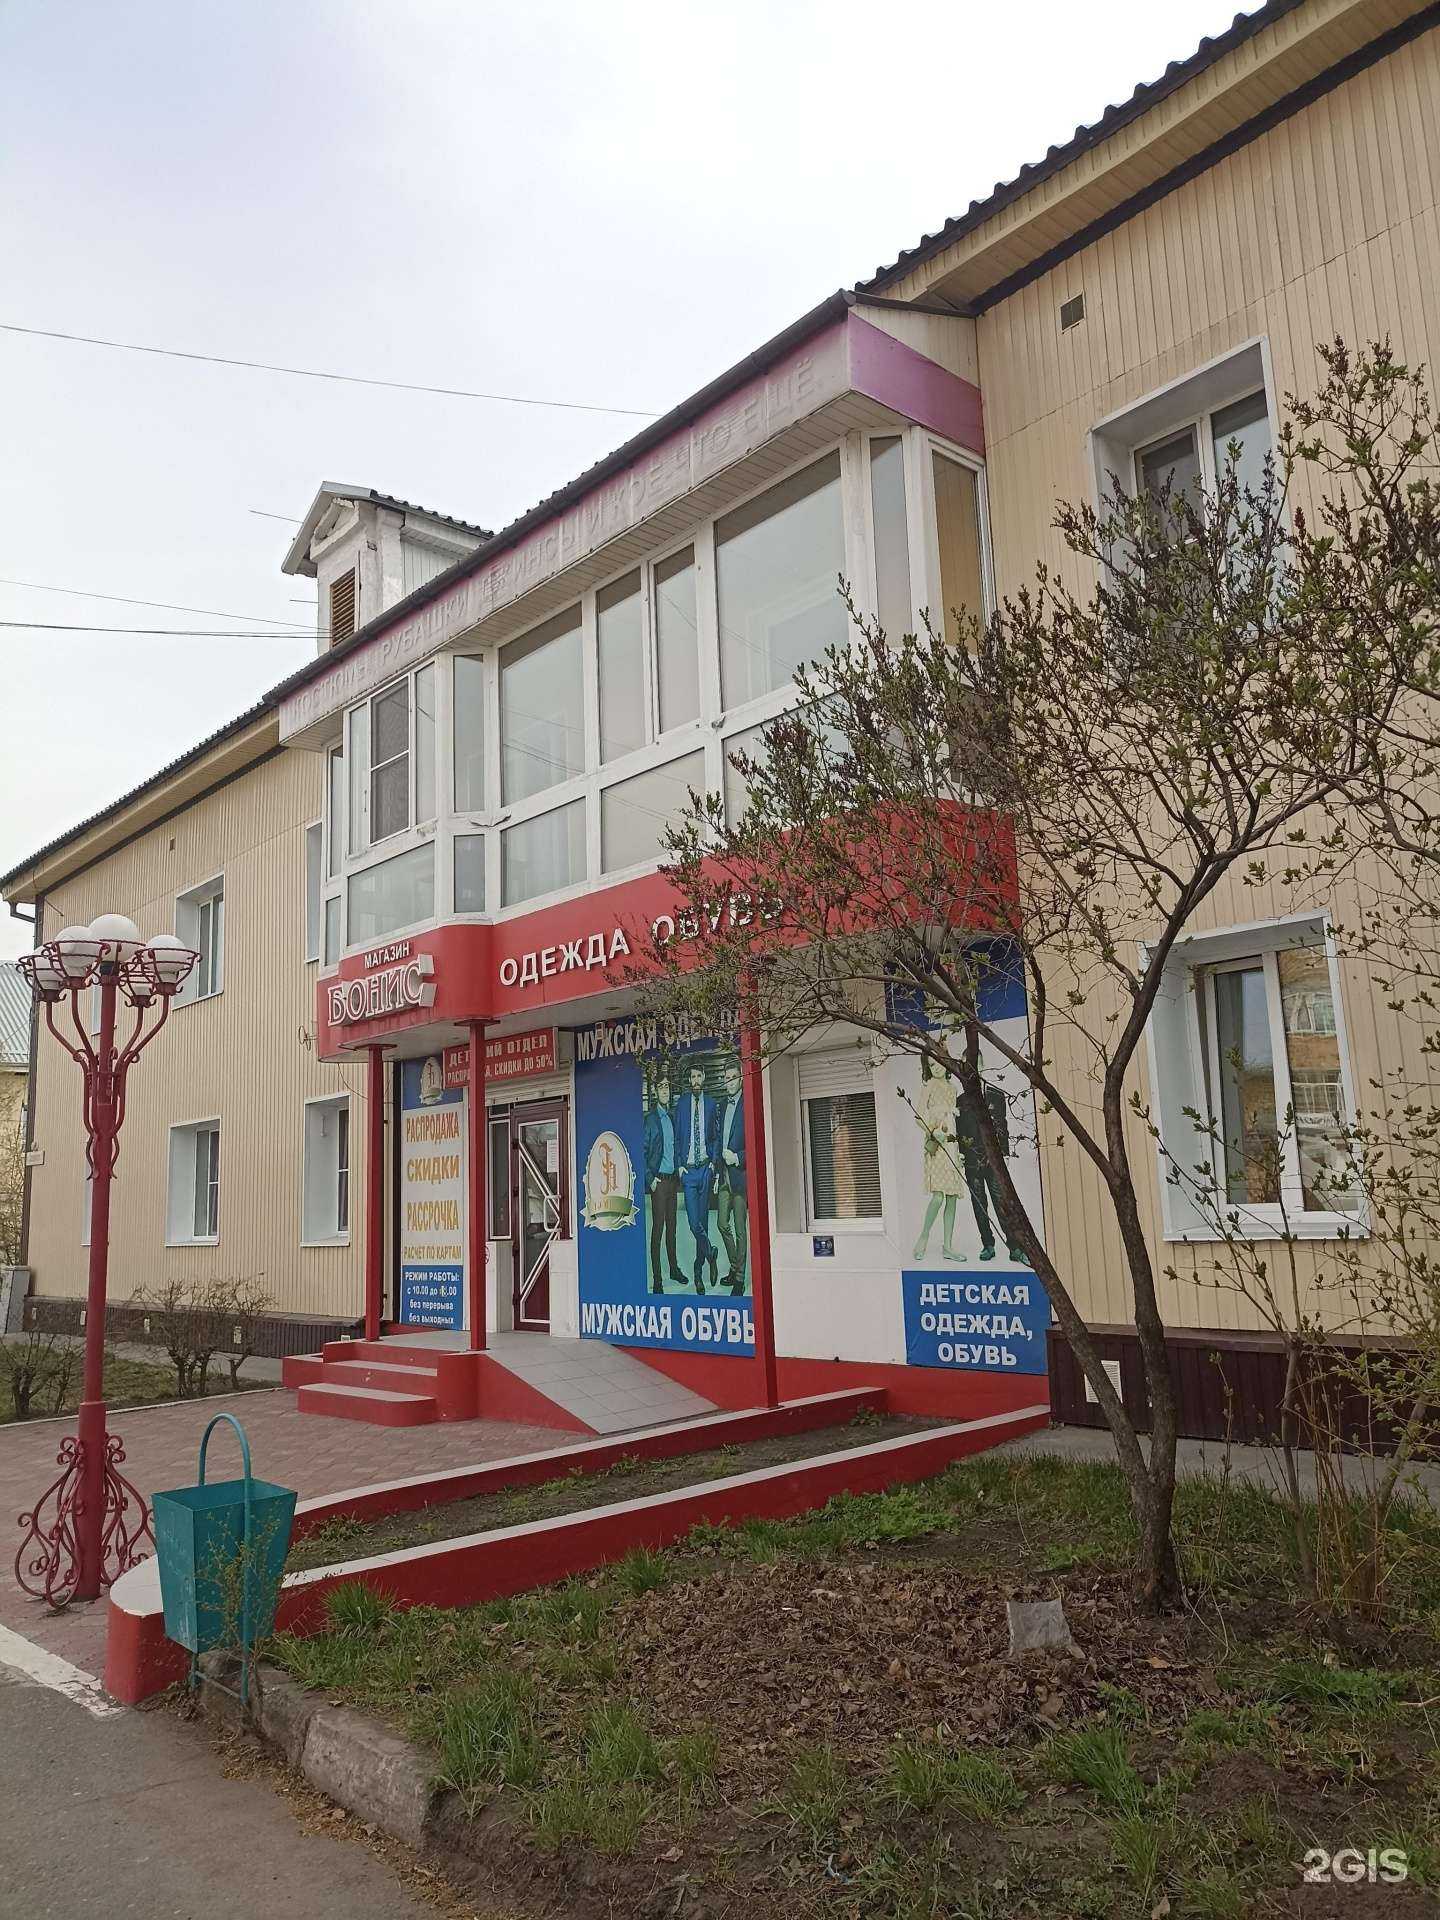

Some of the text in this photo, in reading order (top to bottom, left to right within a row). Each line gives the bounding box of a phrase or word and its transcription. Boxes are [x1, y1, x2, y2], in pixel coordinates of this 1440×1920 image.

[364, 941, 410, 969] МАГАЗИН
[499, 928, 630, 987] ОДЕЖДА
[327, 954, 437, 1026] БОНИС
[449, 1035, 547, 1067] ДЕТИЙ ОТДЕЛ
[577, 1017, 657, 1062] МУЖСКАЯ
[494, 1059, 521, 1077] СКИДКИ
[524, 1057, 534, 1073] ДО
[535, 1053, 553, 1069] 50%
[406, 1111, 460, 1144] РАСПРОДАЖА
[406, 1154, 460, 1184] СКИДКИ
[407, 1200, 460, 1231] РАССРОЧКА
[405, 1271, 460, 1282] РЕЖИМ РАБОТЫ:
[409, 1299, 454, 1311] без перерыва
[919, 1283, 1030, 1306] ДЕТСКАЯ
[409, 1313, 454, 1324] без выходных
[582, 1303, 755, 1344] МУЖСКАЯ ОБУВЬ
[920, 1312, 1033, 1341] ОДЕЖДА,
[937, 1343, 1018, 1367] ОБУВЬ
